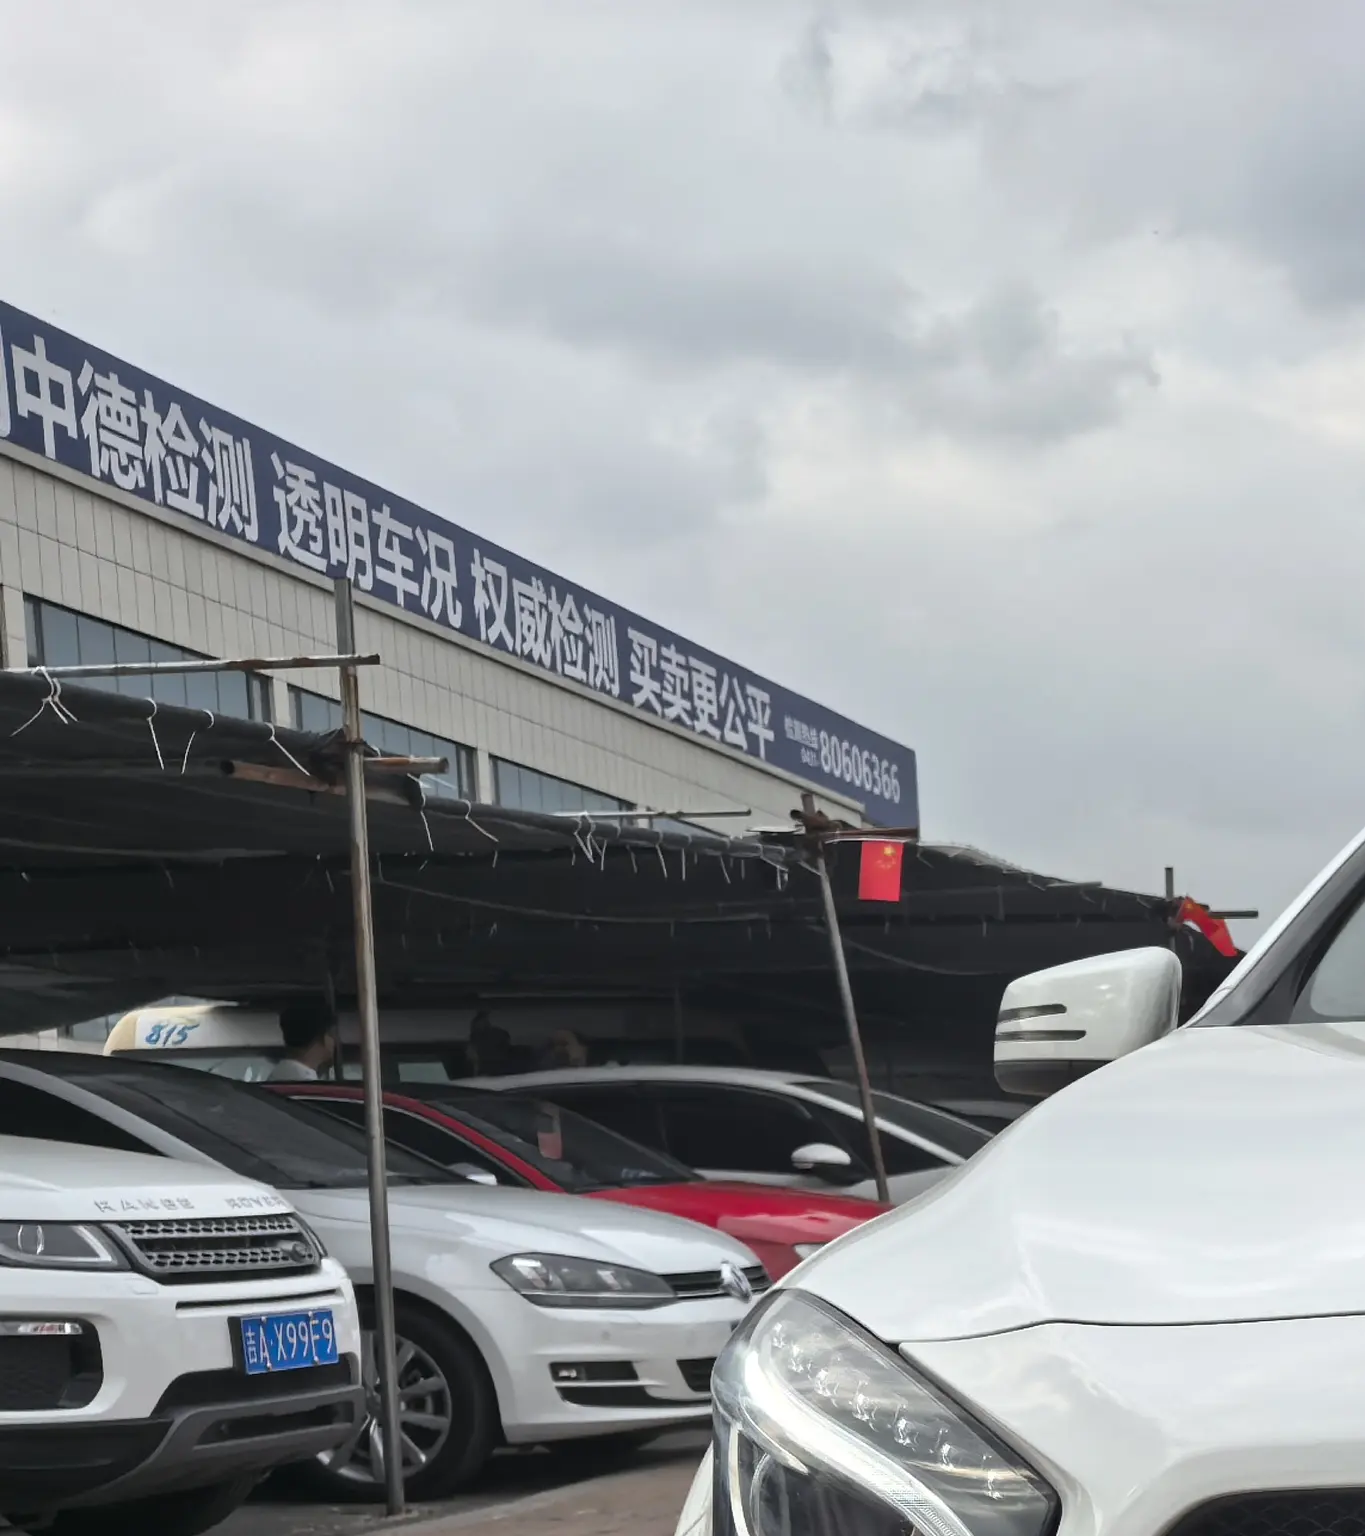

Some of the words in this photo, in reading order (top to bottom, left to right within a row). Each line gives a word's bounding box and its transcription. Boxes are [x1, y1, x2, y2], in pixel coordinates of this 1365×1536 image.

[0, 323, 259, 543] 中德检测
[271, 451, 463, 630] 透明车况
[471, 548, 621, 698] 权威检测
[627, 627, 775, 760] 买卖更公平
[820, 731, 900, 804] 80606366
[145, 1023, 199, 1047] 815
